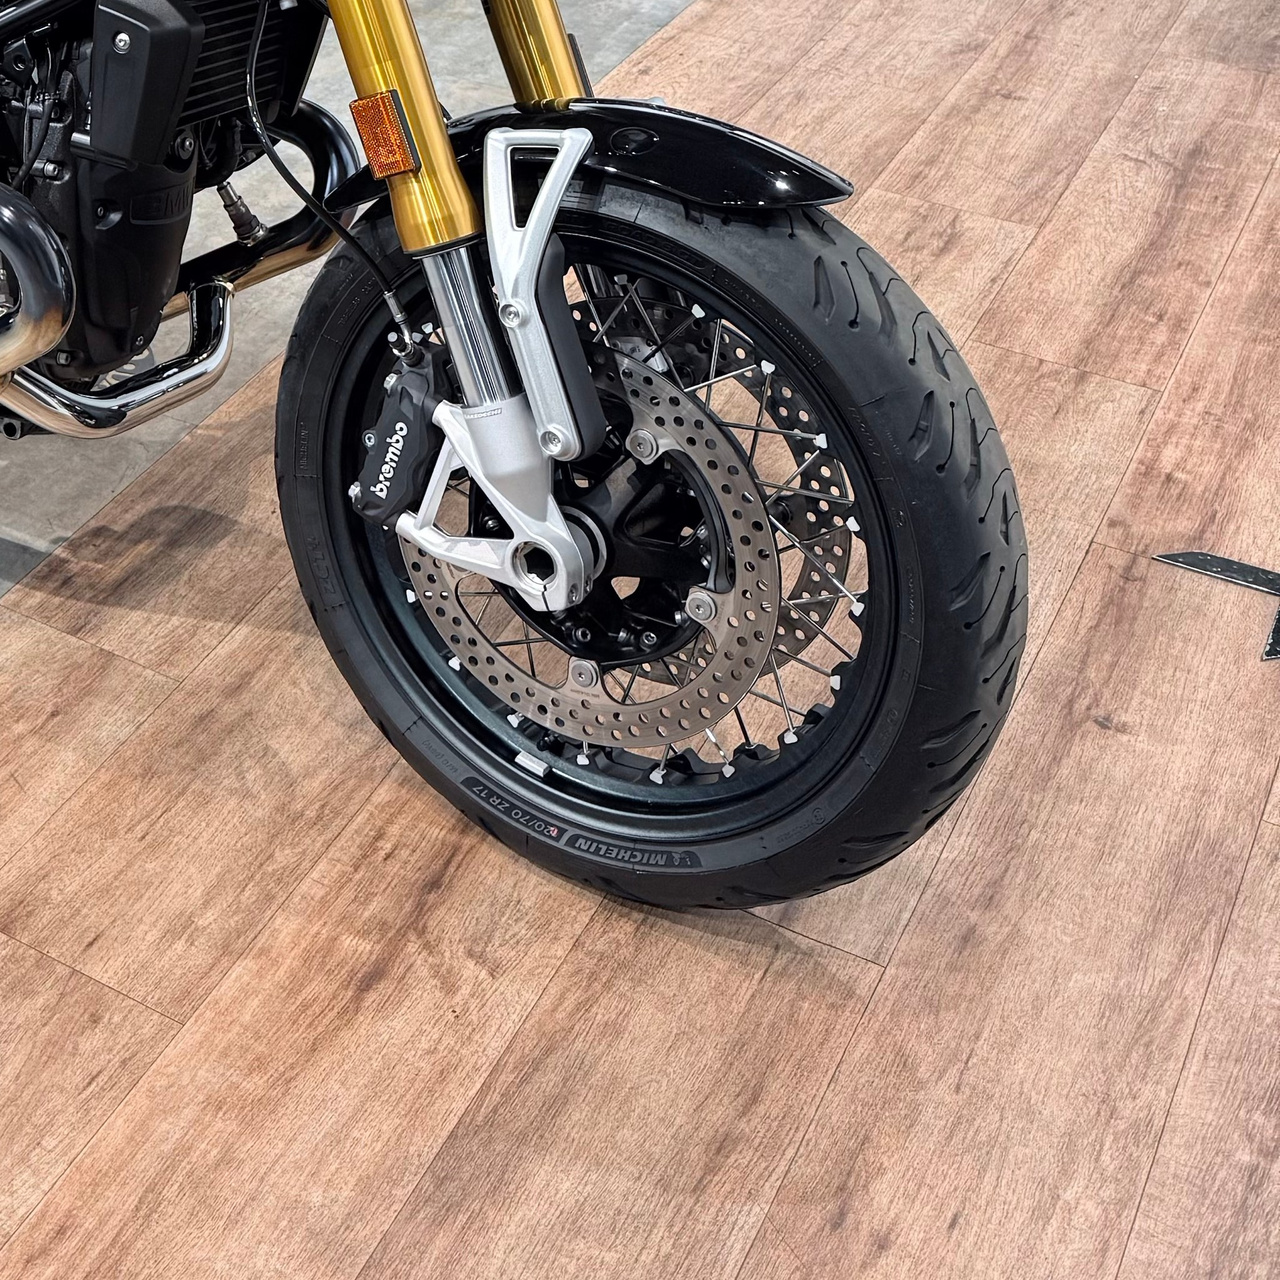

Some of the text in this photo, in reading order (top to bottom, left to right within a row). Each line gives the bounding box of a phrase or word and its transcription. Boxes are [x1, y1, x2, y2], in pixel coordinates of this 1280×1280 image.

[370, 421, 408, 499] brembo
[472, 786, 488, 798] 17
[489, 796, 510, 811] ZR
[575, 837, 669, 866] MICHELIN
